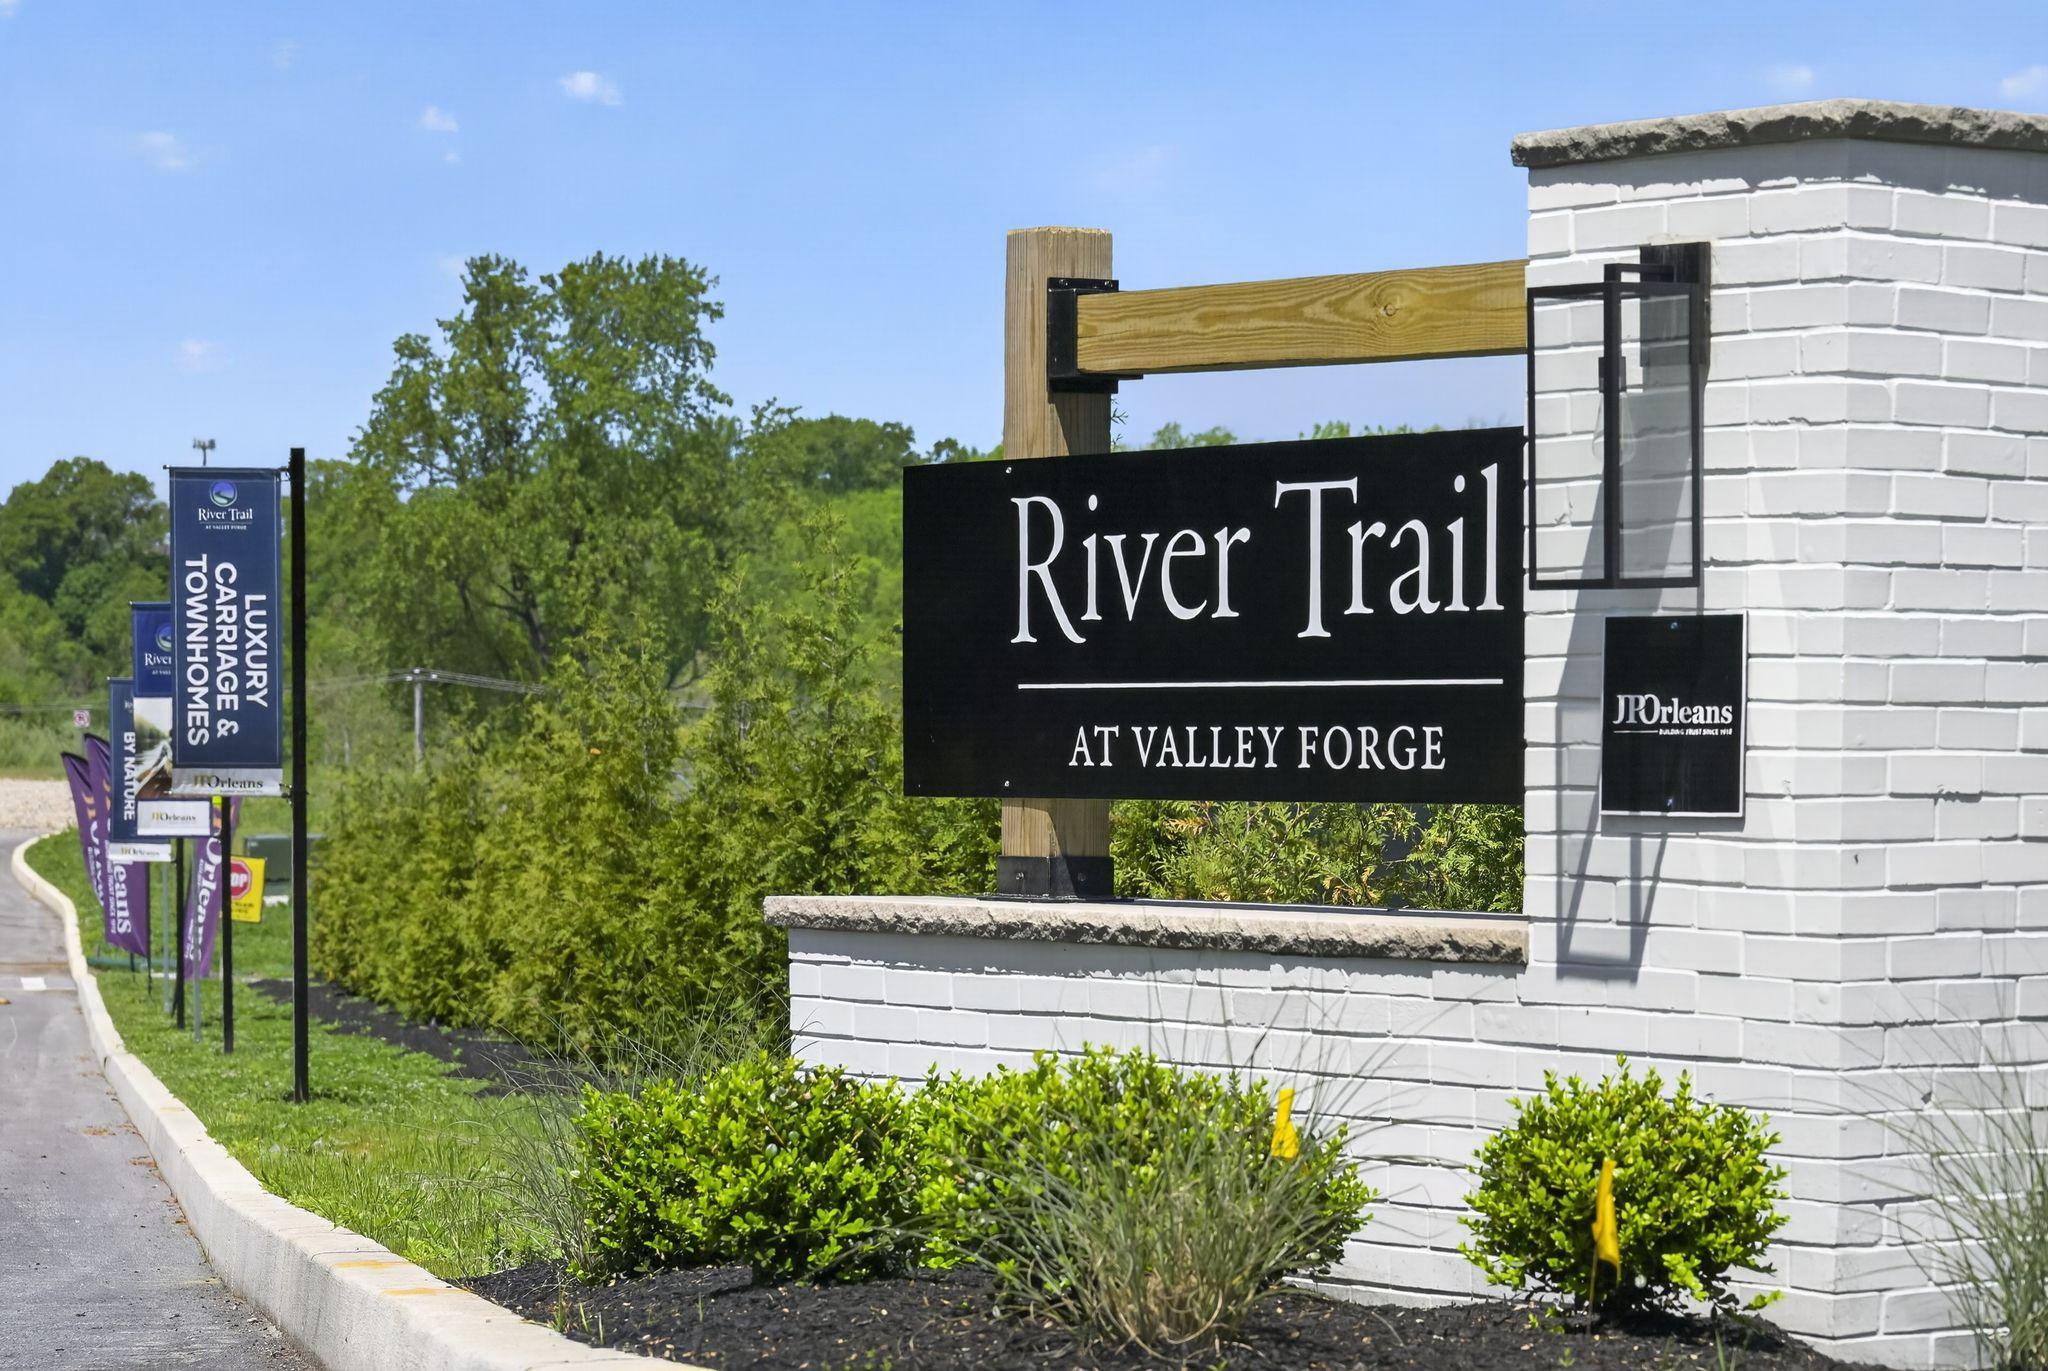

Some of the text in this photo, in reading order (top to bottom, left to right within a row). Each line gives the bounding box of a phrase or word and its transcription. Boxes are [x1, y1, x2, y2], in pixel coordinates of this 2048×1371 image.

[198, 508, 253, 521] River Trail
[1010, 462, 1505, 644] River Trail
[185, 553, 210, 746] TOWNHOMES
[214, 561, 239, 738] CARRIAGE &
[244, 594, 268, 708] LUXURY
[1068, 725, 1446, 770] AT VALLEY FORGE
[1612, 693, 1733, 725] JPOrleans
[123, 731, 136, 821] BY NATURE
[231, 872, 248, 888] OP
